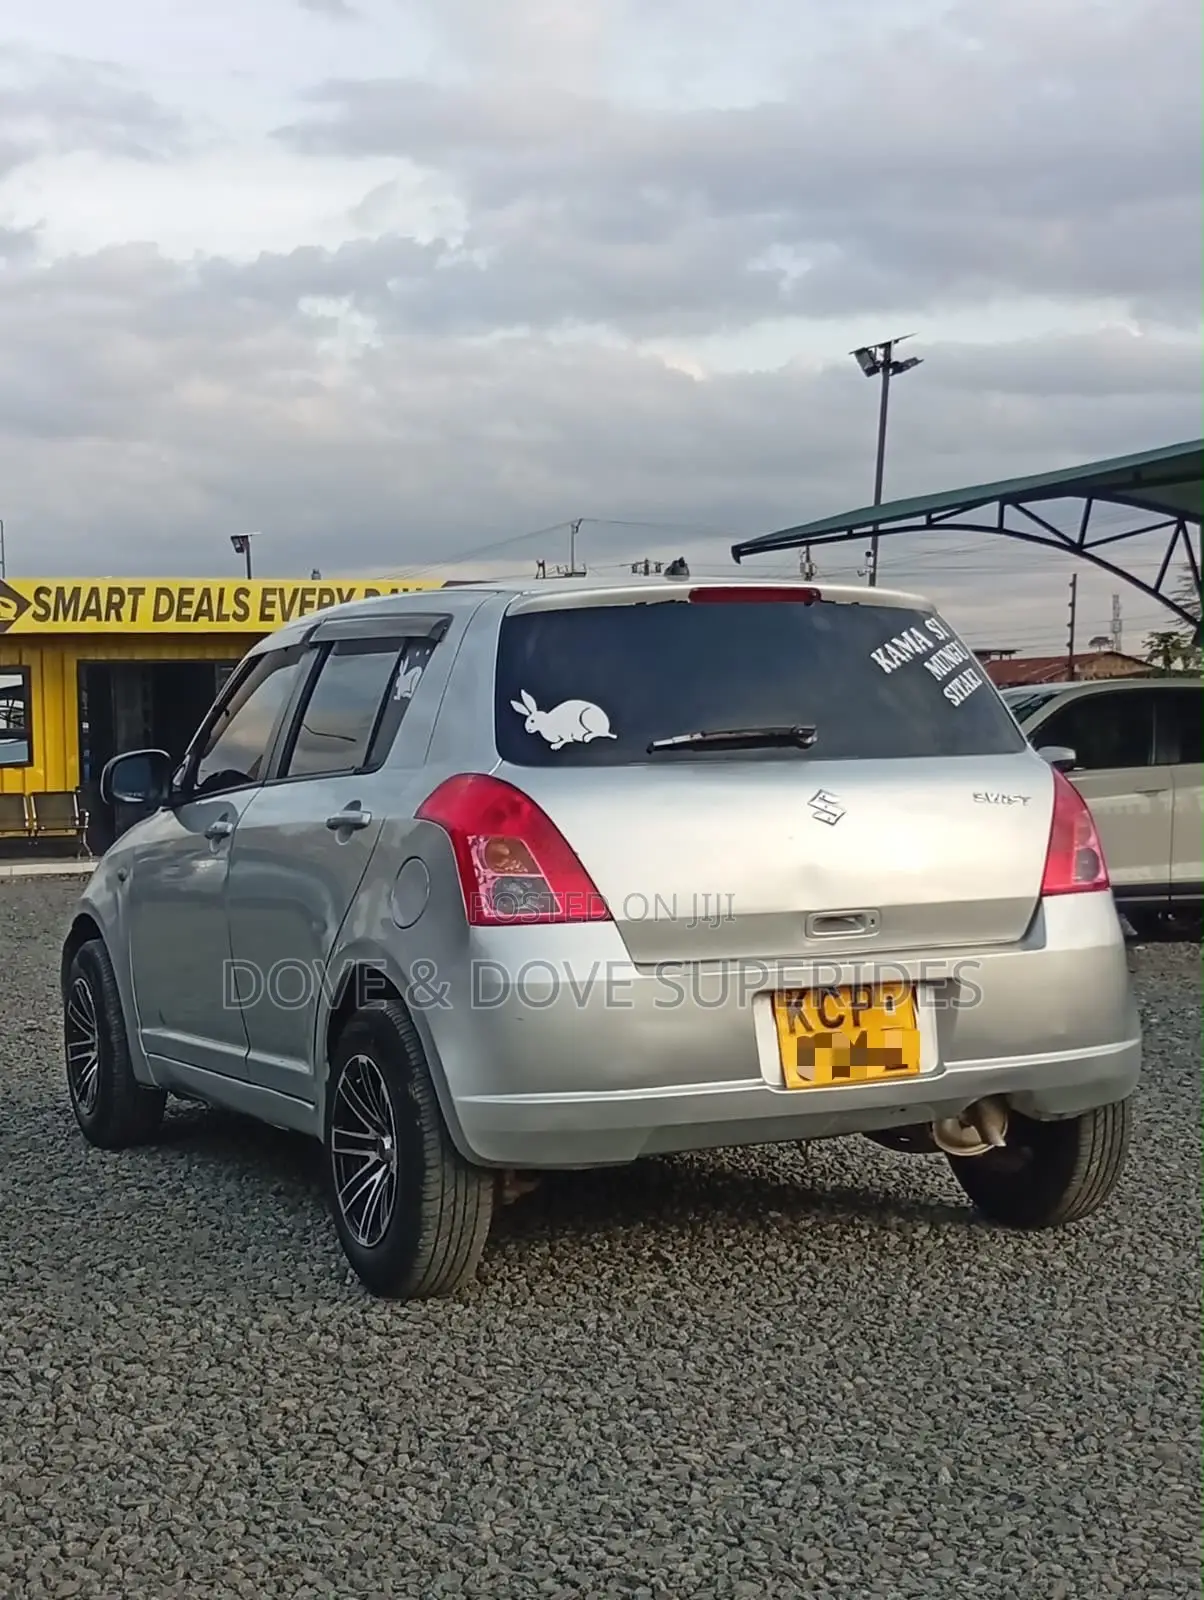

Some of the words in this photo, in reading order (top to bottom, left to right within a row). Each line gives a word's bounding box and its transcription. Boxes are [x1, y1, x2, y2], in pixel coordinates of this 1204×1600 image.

[31, 586, 145, 623] SMART
[152, 586, 251, 623] DEALS
[870, 627, 935, 674] KAMA
[924, 617, 950, 641] SI
[923, 640, 970, 681] MUNGU
